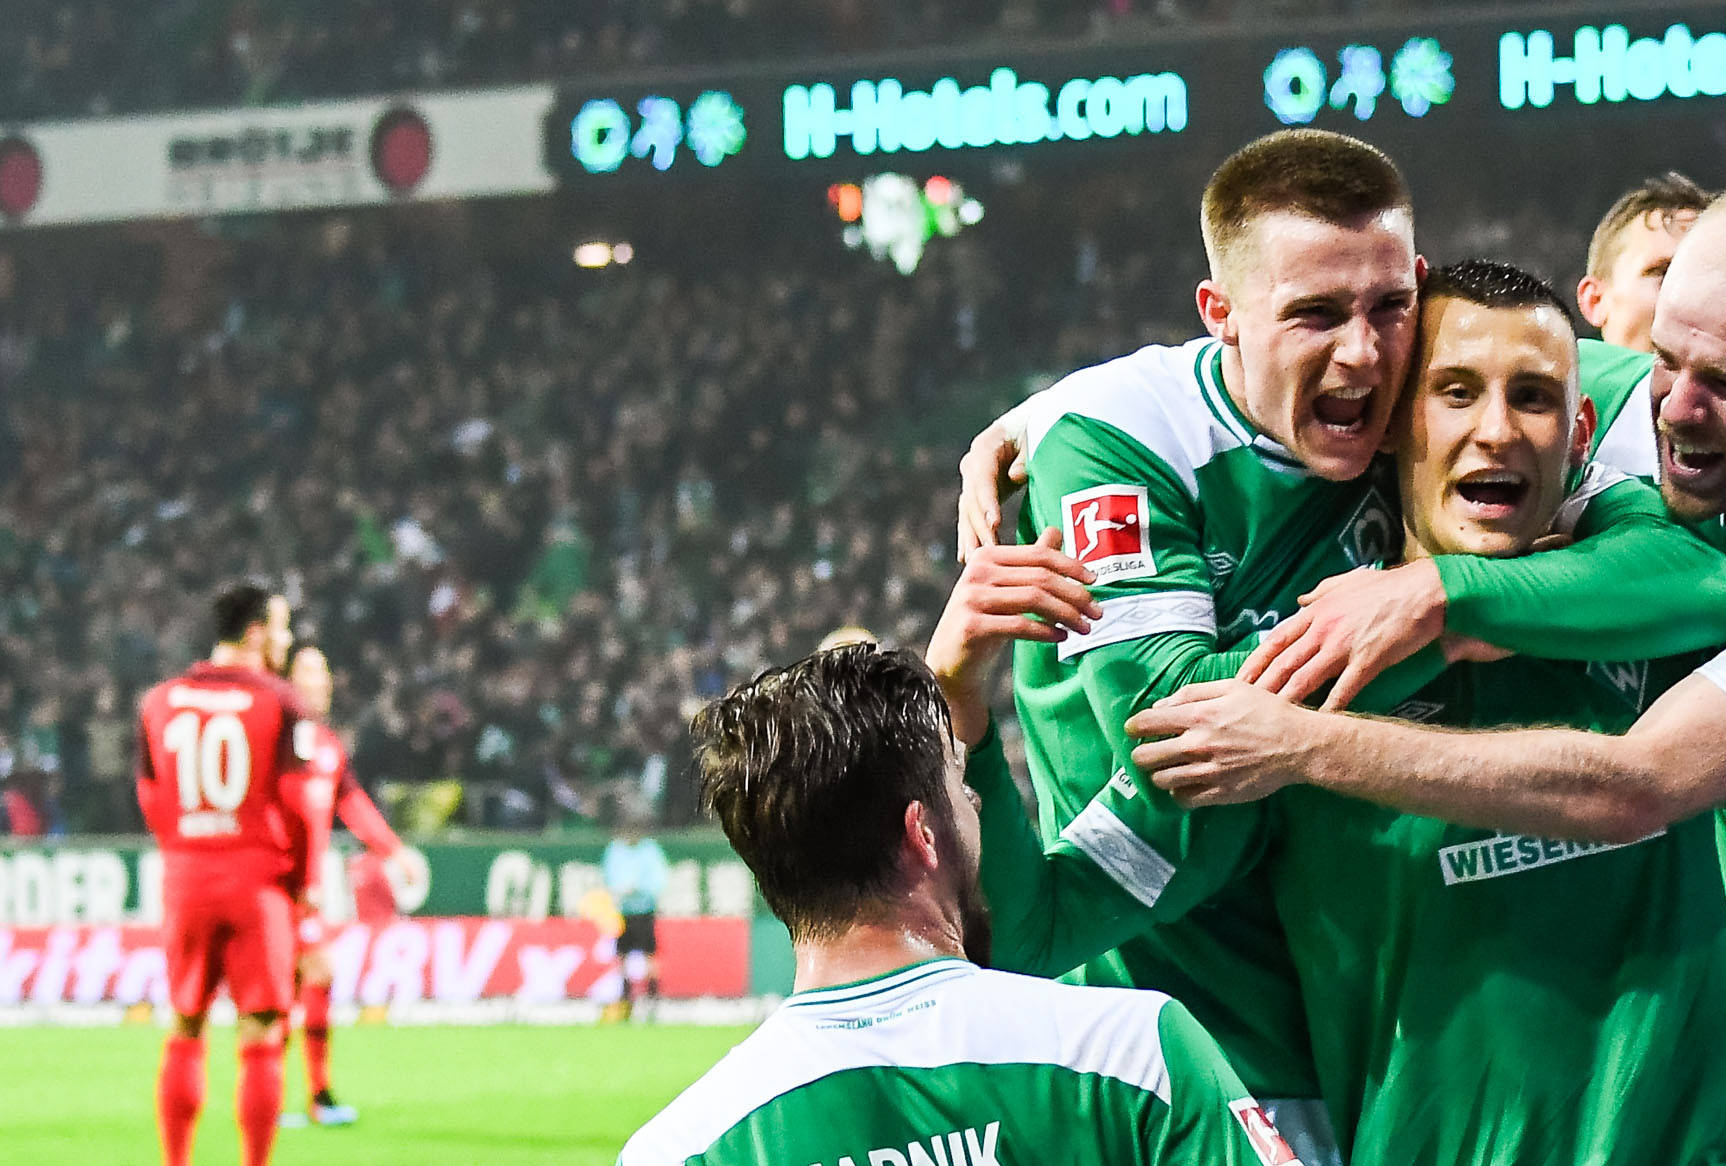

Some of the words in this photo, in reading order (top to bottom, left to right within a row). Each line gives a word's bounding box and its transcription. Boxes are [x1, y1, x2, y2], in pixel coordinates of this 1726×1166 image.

[783, 67, 1188, 159] H-Hotels.com
[163, 711, 250, 810] 10
[1446, 835, 1603, 879] WIESE
